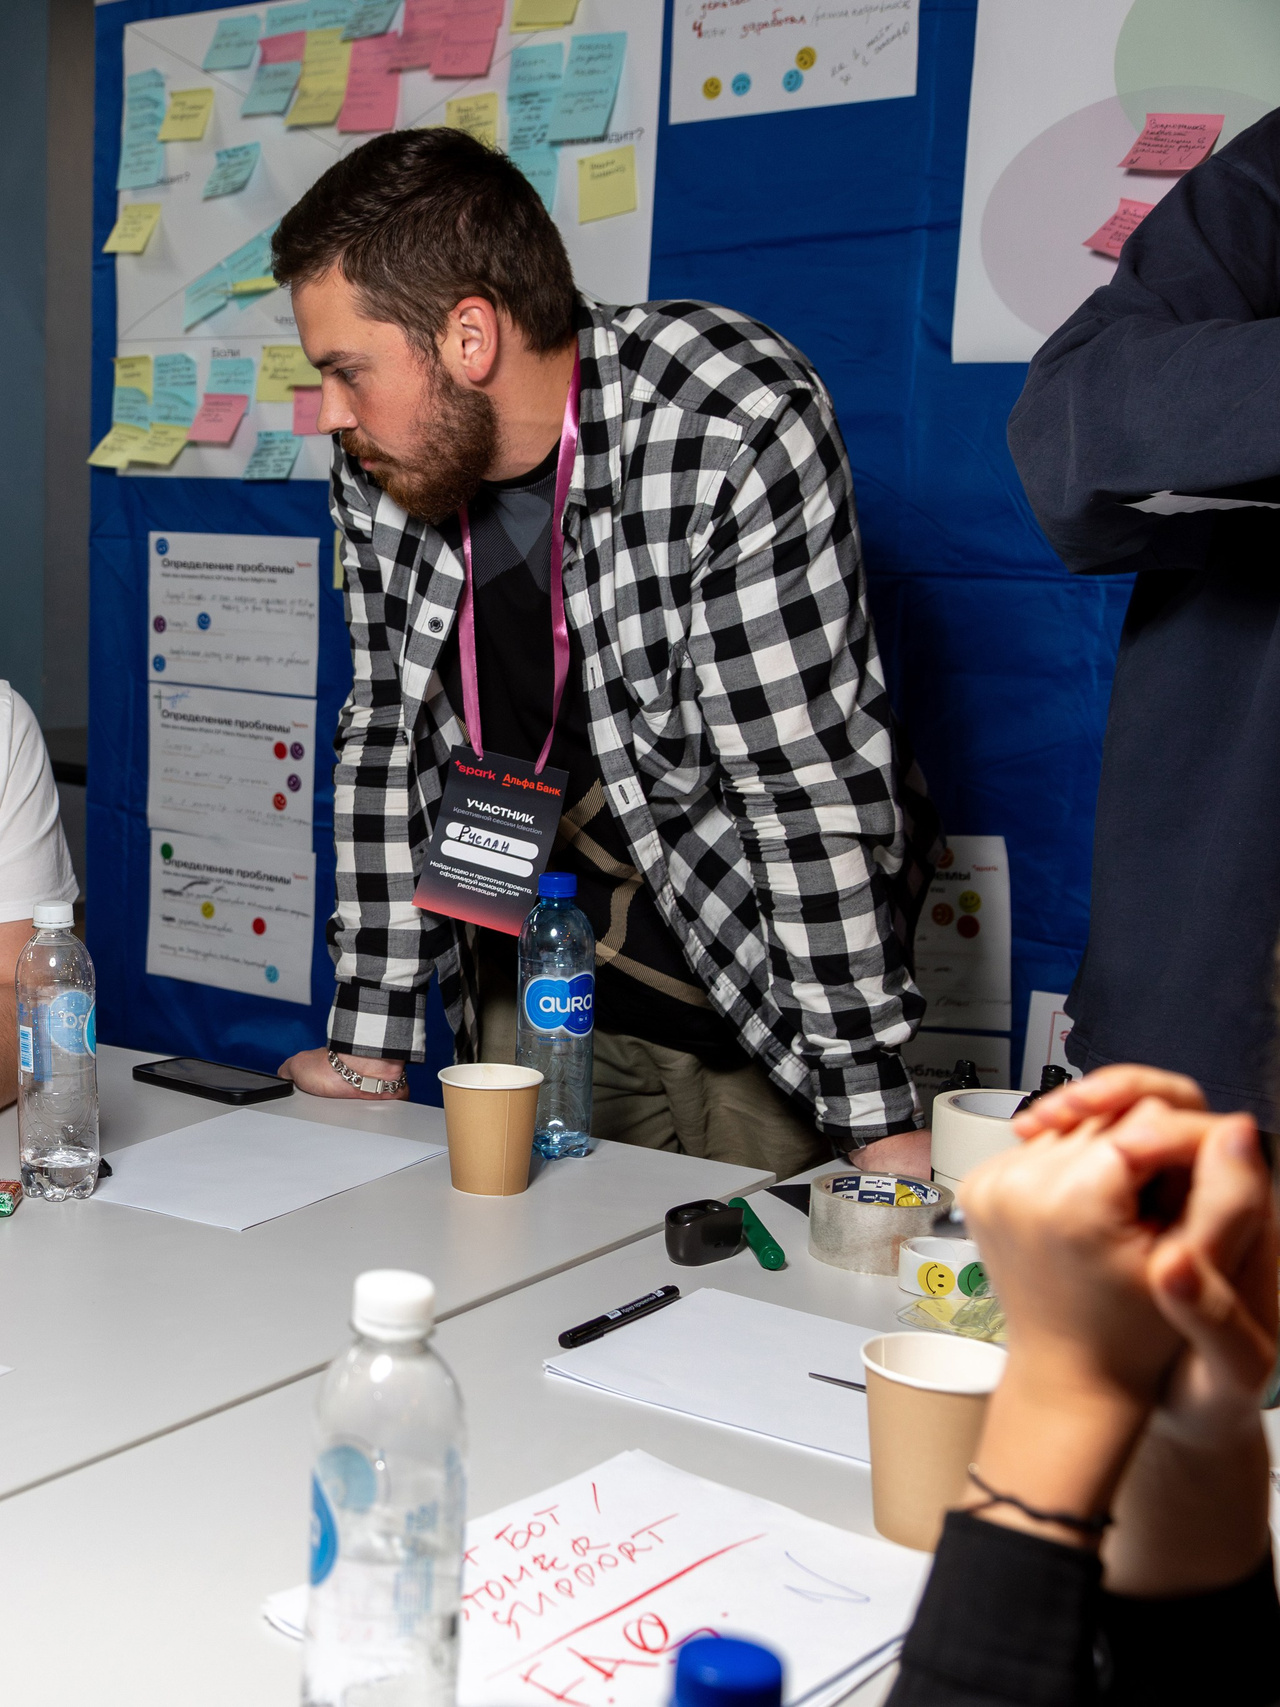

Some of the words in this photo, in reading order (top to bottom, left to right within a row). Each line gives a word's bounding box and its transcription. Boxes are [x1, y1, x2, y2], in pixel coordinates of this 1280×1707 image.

[161, 557, 234, 572] Определение
[236, 562, 295, 575] проблемы
[161, 709, 233, 727] Определение
[234, 718, 291, 734] проблемы
[458, 763, 496, 780] spark
[502, 773, 535, 789] Альфа
[536, 782, 561, 796] Банк
[453, 806, 492, 822] Креативной
[492, 816, 516, 828] сессии
[466, 798, 535, 825] УЧАСТНИК
[235, 867, 291, 885] проблемы
[430, 860, 451, 871] Найди
[451, 867, 469, 876] идею
[475, 873, 504, 886] прототип
[439, 870, 478, 886] сформируй
[478, 882, 507, 893] команду
[506, 889, 520, 897] для
[457, 883, 497, 898] реализации
[539, 993, 592, 1013] aura
[461, 1536, 610, 1622] TOMER
